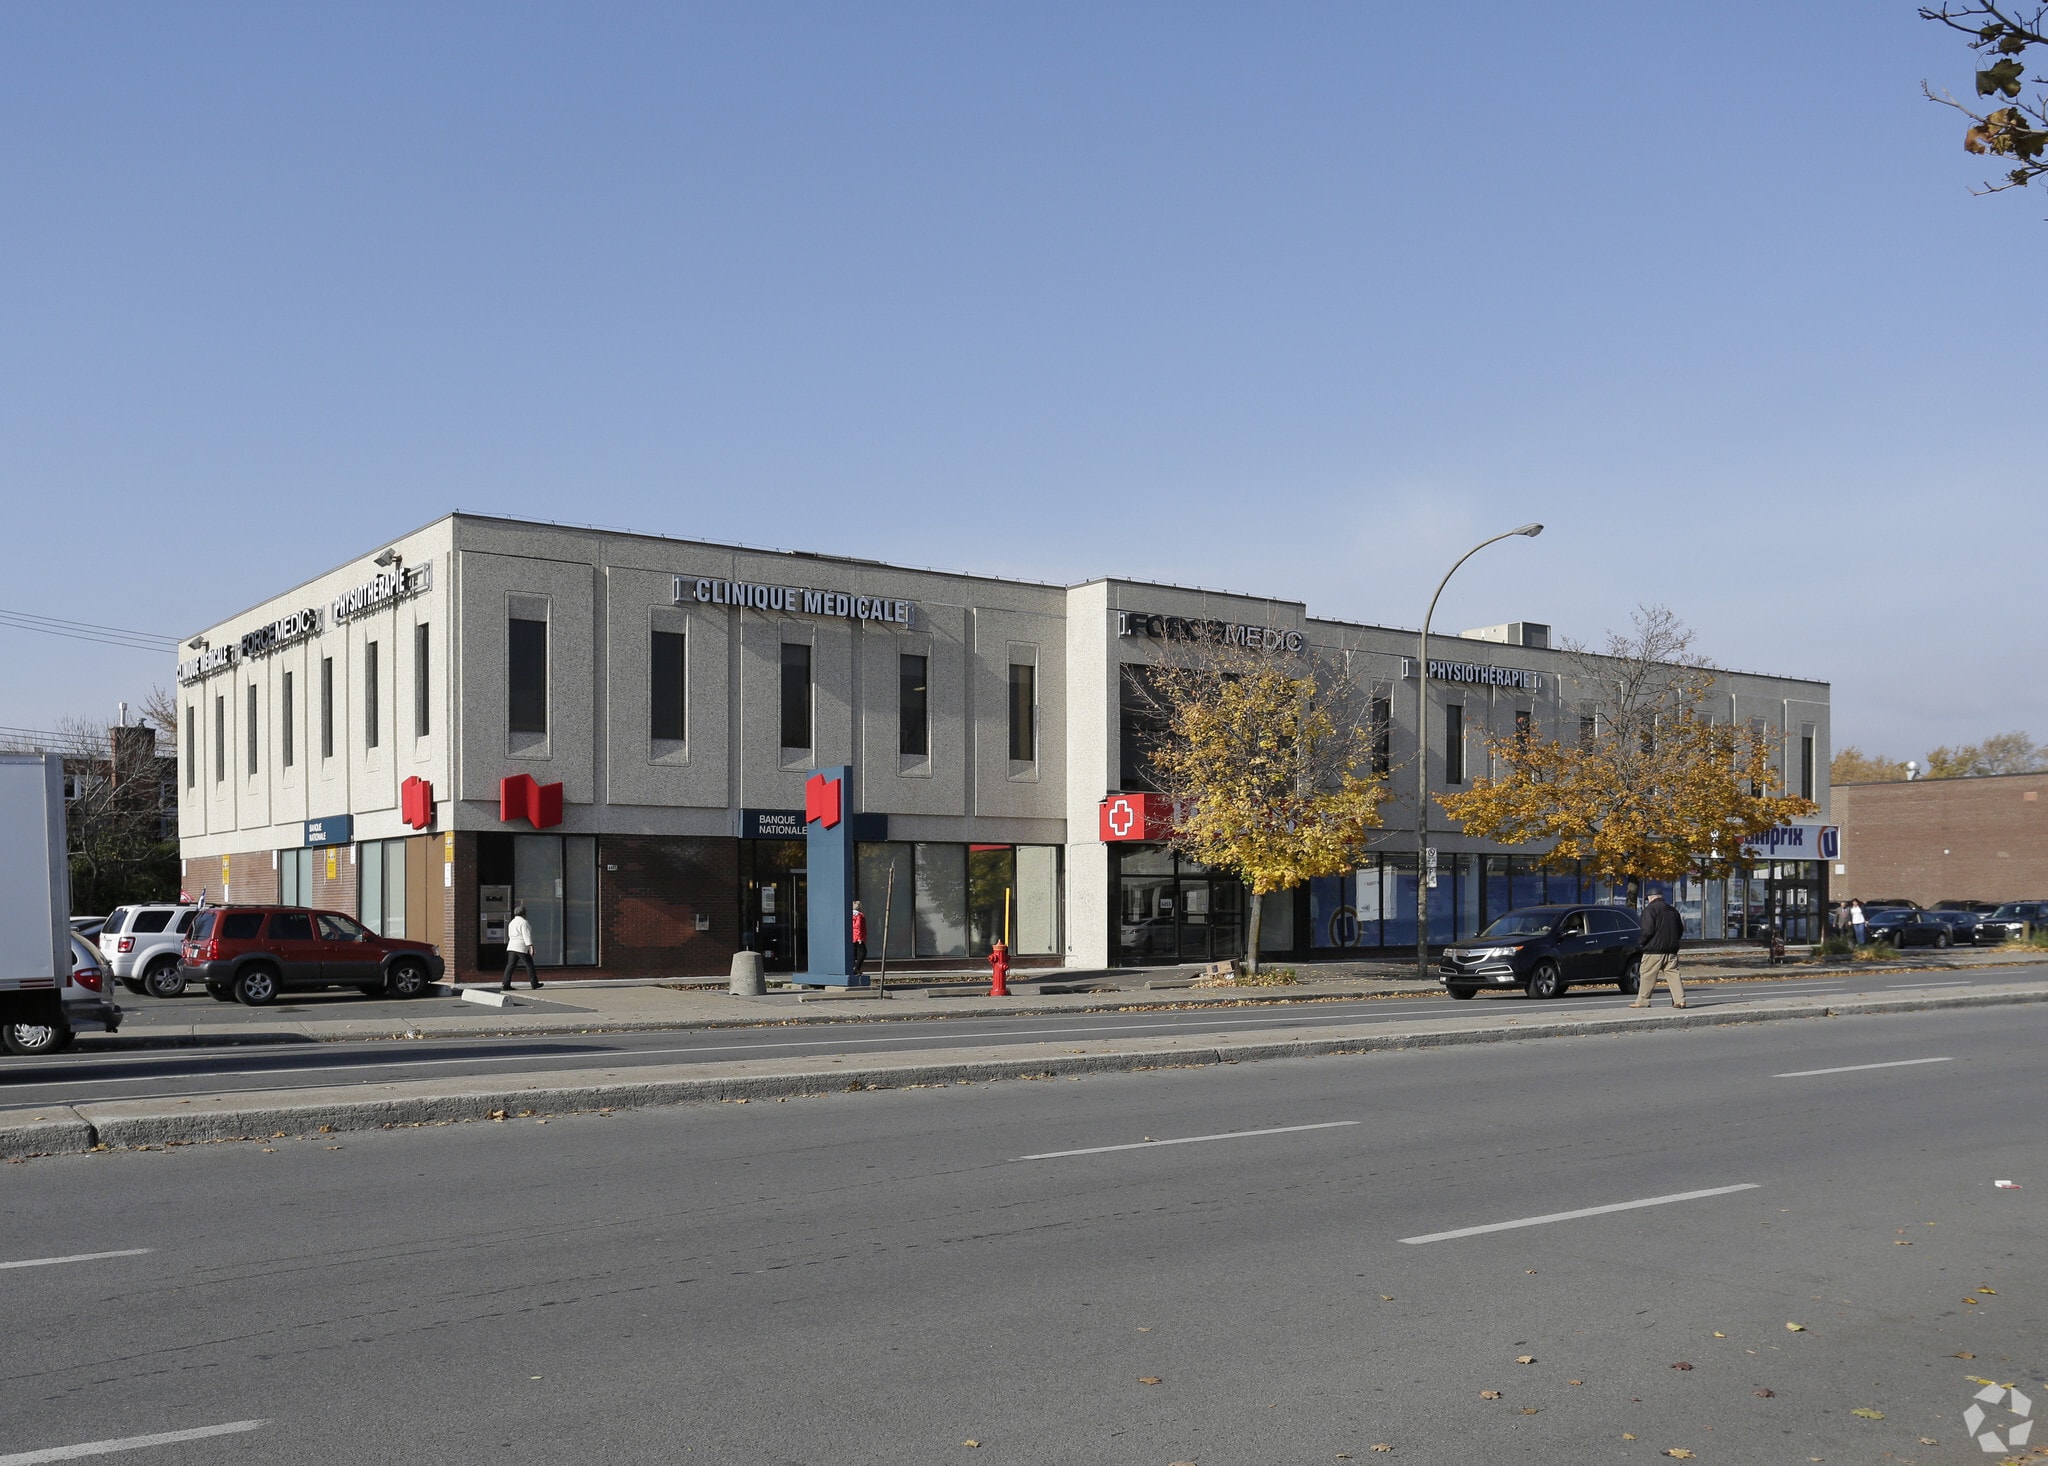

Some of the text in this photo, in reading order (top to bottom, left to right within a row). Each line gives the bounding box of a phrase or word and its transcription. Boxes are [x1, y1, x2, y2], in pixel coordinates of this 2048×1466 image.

[696, 578, 797, 612] CLINIQUE
[759, 814, 796, 825] BANQUE
[759, 825, 808, 835] NATIONALE
